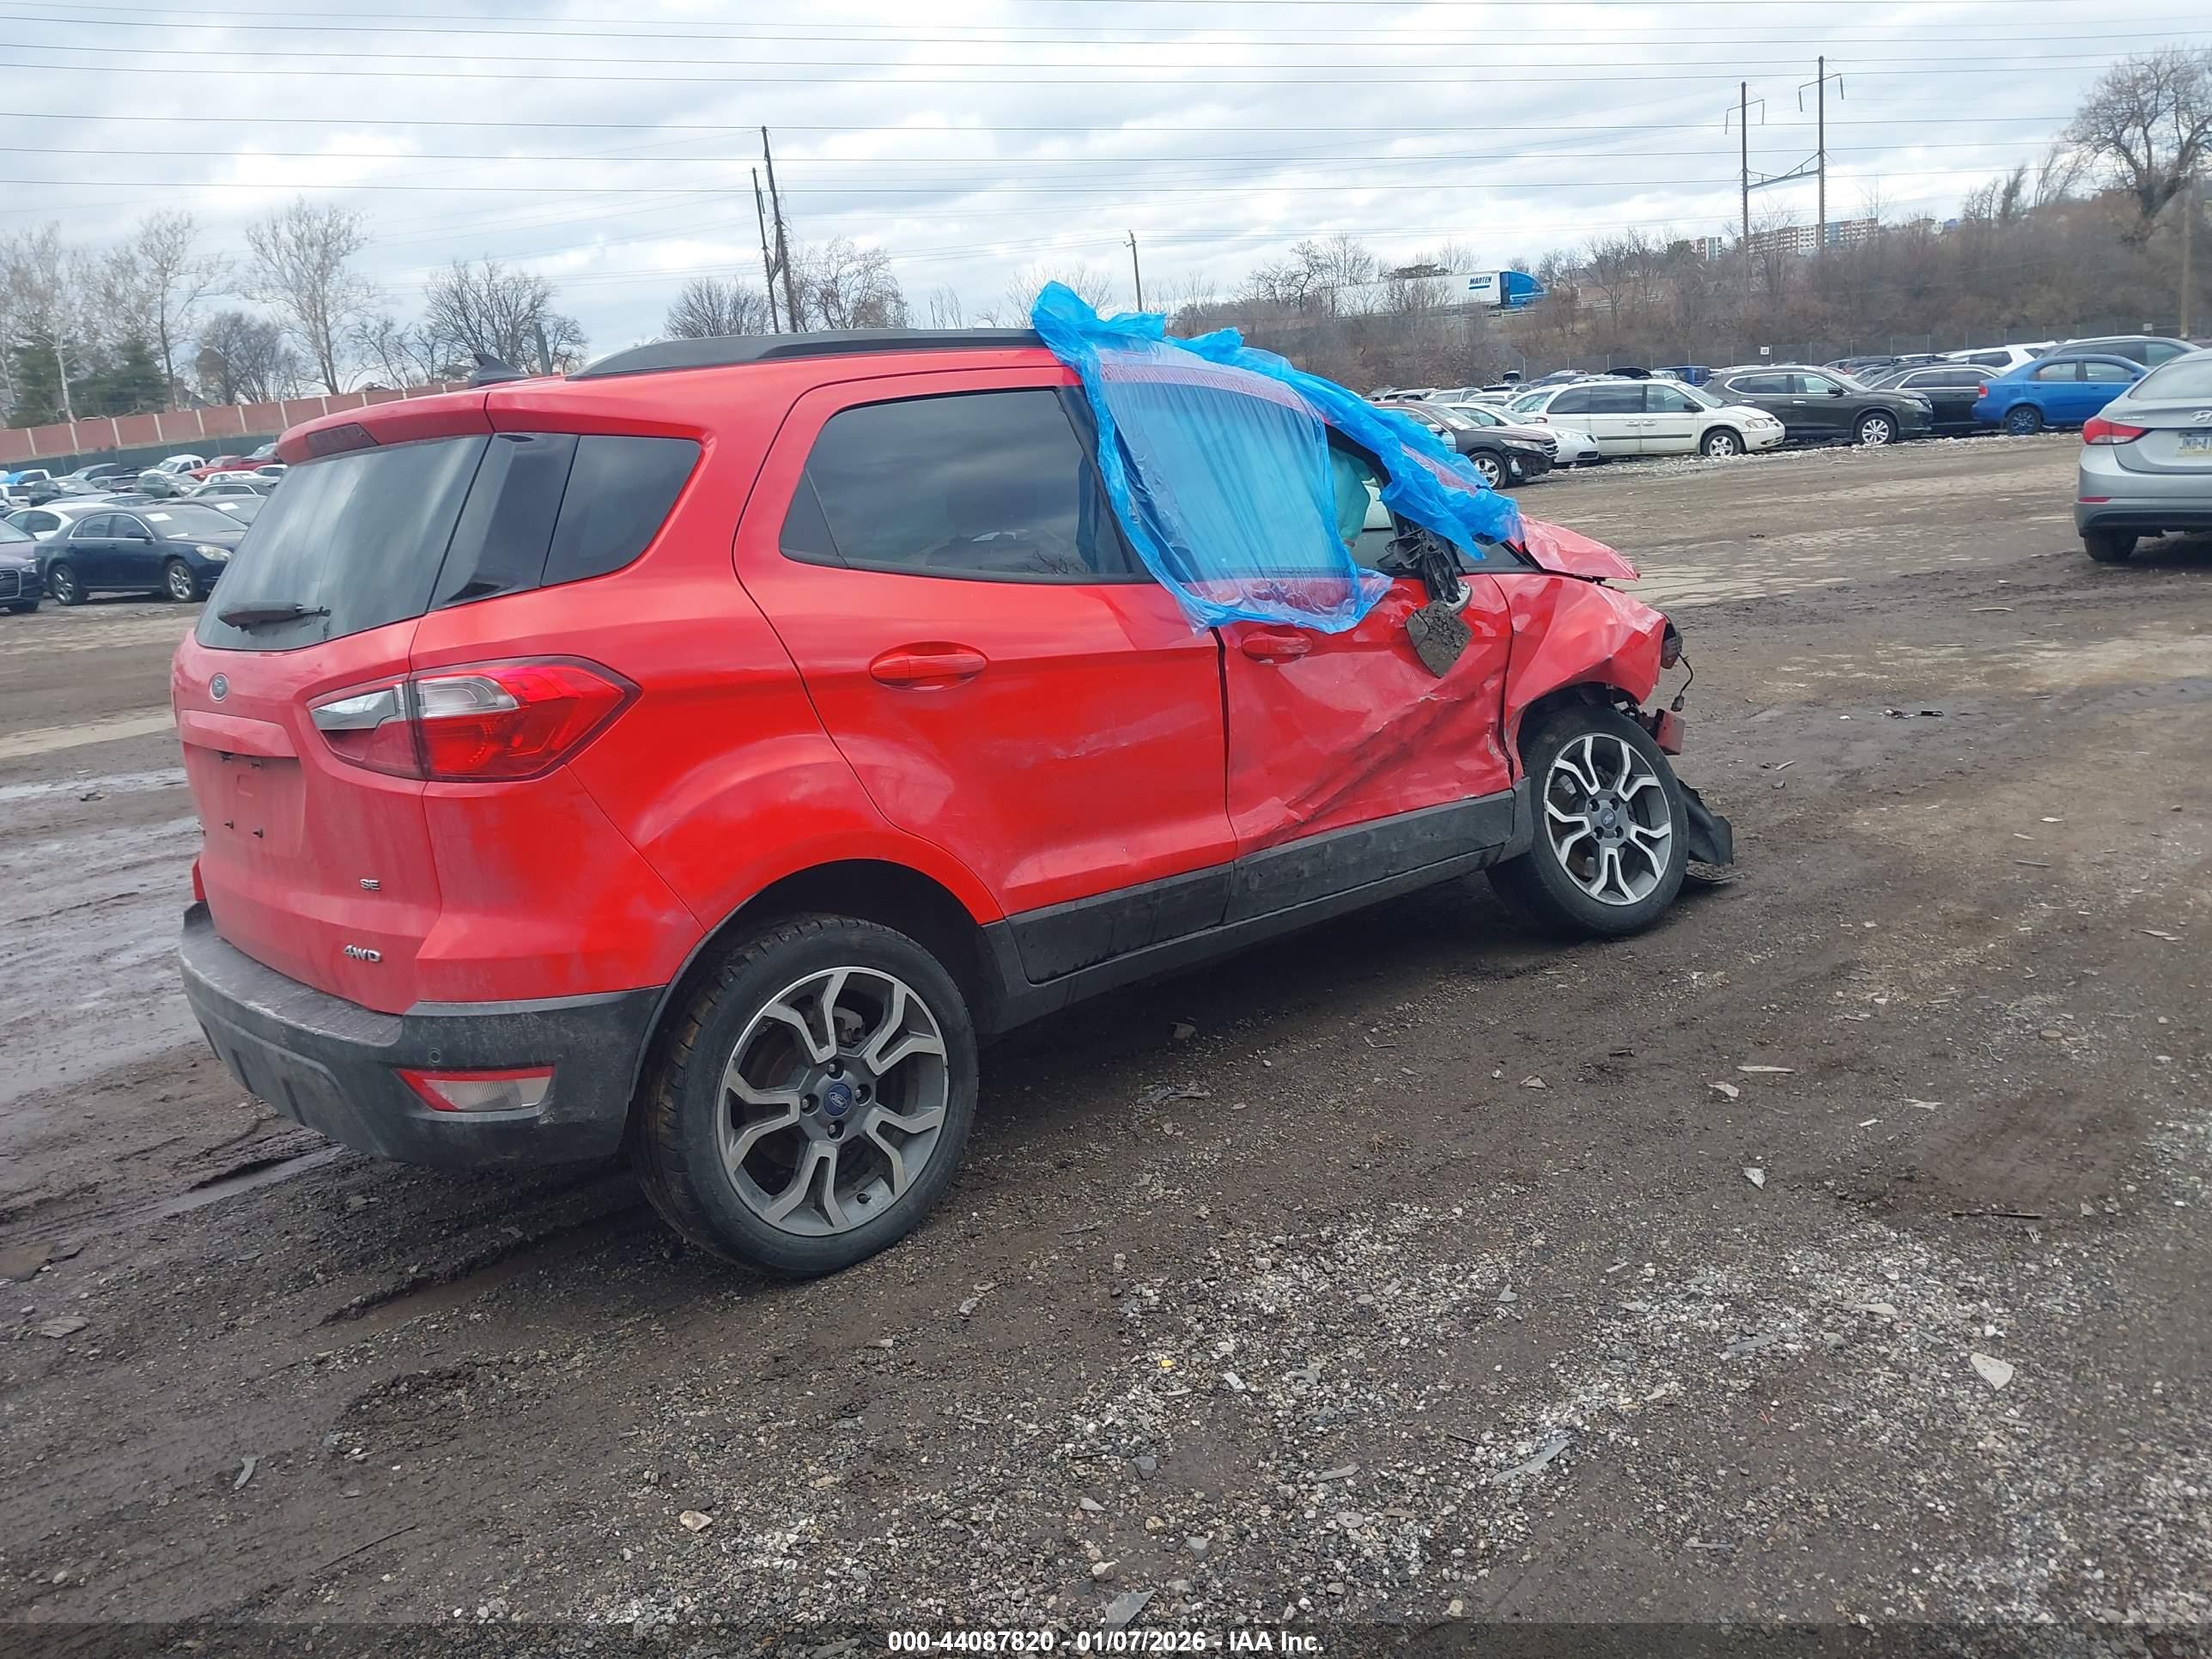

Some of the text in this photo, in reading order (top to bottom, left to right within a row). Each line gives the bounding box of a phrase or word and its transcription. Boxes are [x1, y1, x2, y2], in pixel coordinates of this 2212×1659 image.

[1469, 276, 1492, 285] MARTEN
[360, 878, 380, 890] SE
[343, 944, 382, 963] 4WD
